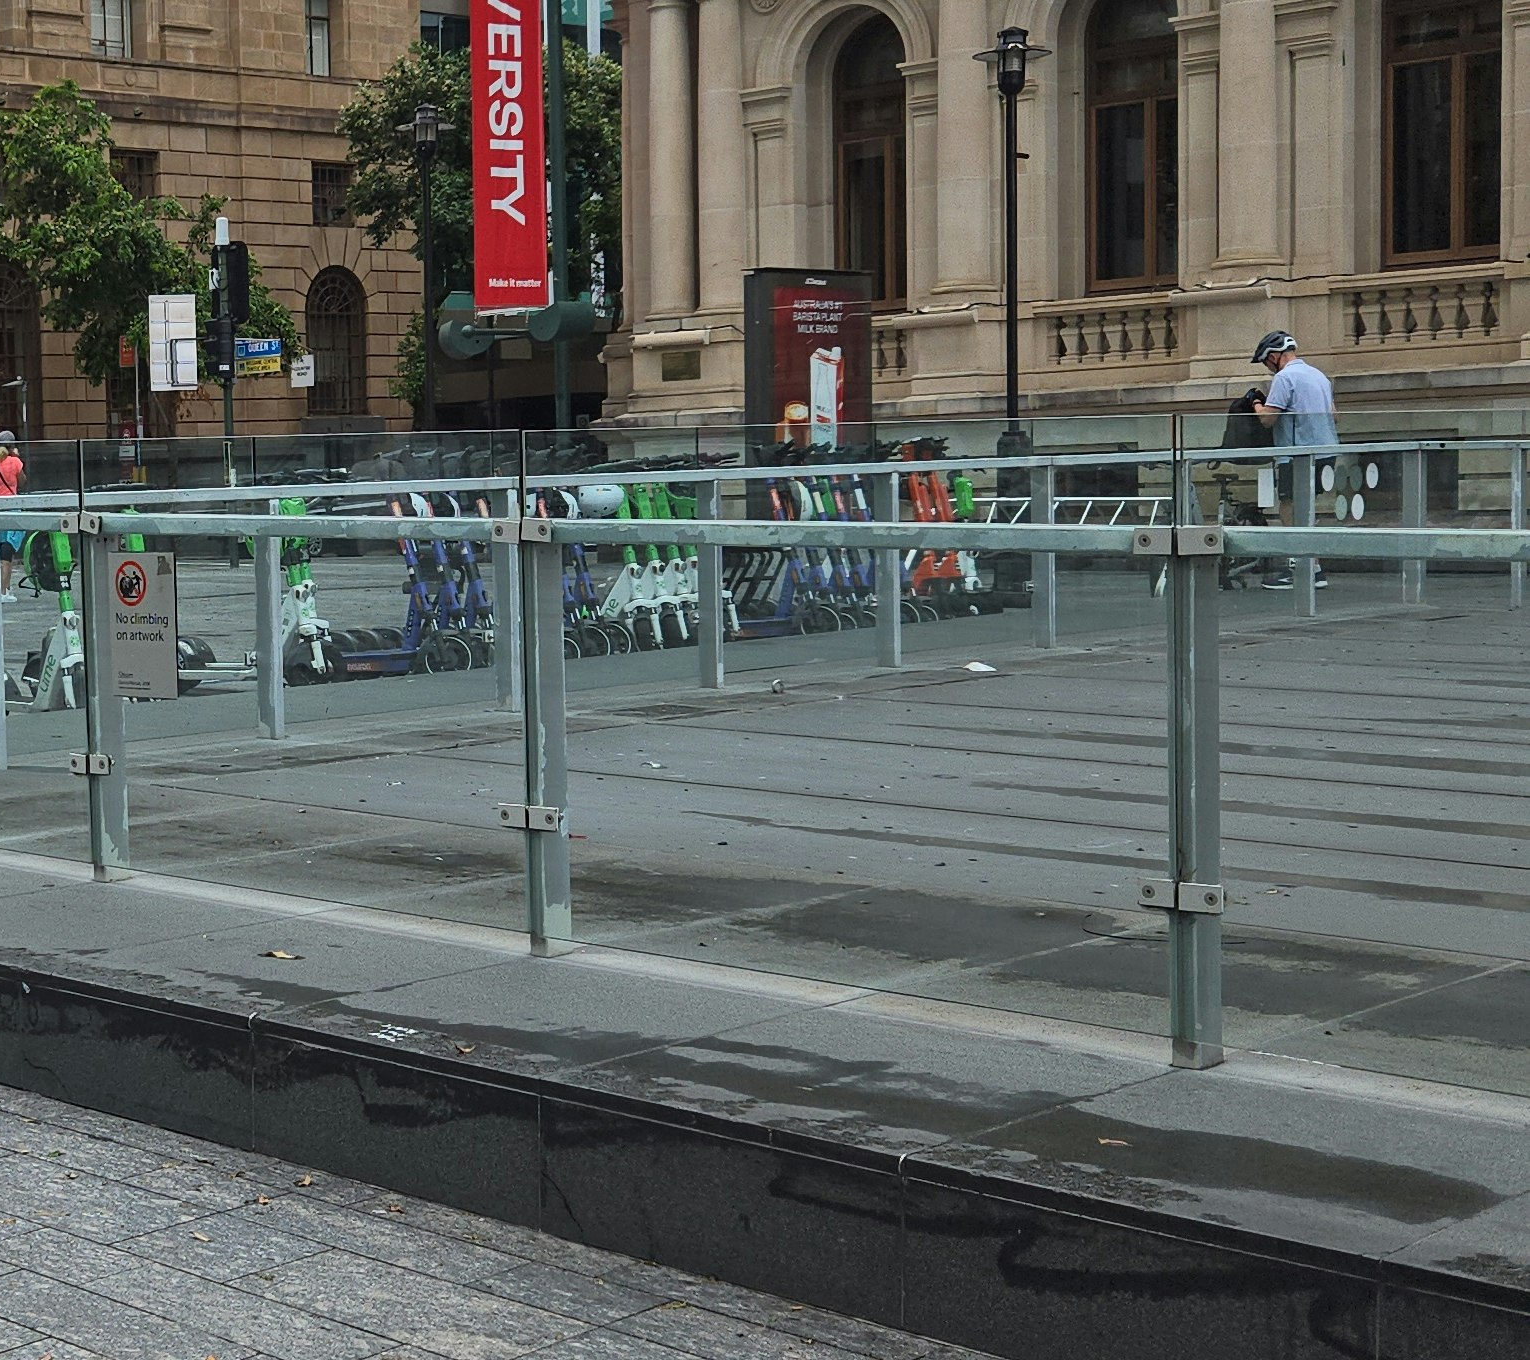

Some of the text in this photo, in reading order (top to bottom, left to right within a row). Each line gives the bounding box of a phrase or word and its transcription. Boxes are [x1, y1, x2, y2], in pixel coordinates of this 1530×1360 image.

[488, 278, 542, 288] Make it matter
[793, 312, 820, 321] BARISTA
[797, 324, 814, 333] MILK
[248, 342, 268, 352] QUEEN
[115, 612, 169, 628] No climbing
[116, 629, 164, 642] on artwork
